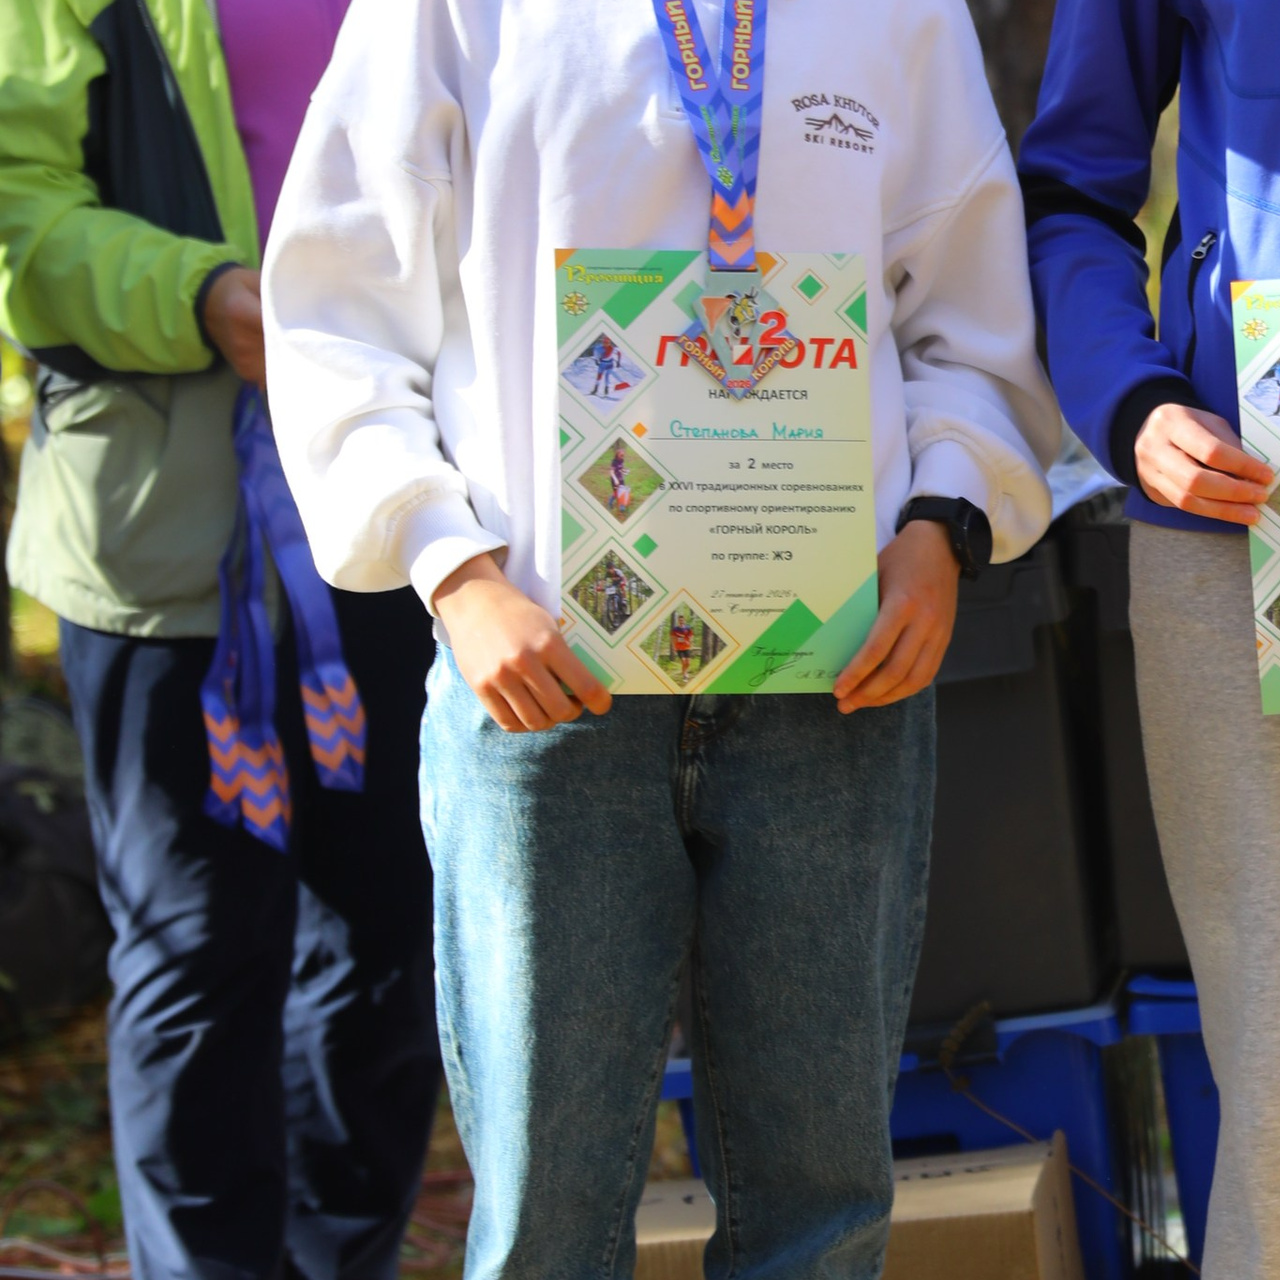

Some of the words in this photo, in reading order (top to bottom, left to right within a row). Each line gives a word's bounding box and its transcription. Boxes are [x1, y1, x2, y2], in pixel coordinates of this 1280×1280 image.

[791, 93, 831, 112] ROSA
[833, 94, 880, 131] KHUTOR
[804, 133, 824, 144] SKI
[830, 137, 874, 154] RESORT
[758, 311, 788, 347] 2
[676, 334, 727, 381] ГОРНЫЙ
[751, 337, 797, 382] КОРОЛЬ
[728, 461, 740, 469] за
[747, 458, 756, 469] 2
[762, 462, 794, 470] место
[668, 482, 694, 491] XXVI
[696, 483, 778, 493] традиционных
[781, 483, 864, 493] соревнованиях
[669, 505, 682, 513] по
[685, 504, 758, 515] спортивному
[761, 505, 856, 514] ориентированию
[709, 523, 763, 535] «ГОРНЫЙ
[765, 524, 818, 536] КОРОЛЬ»
[711, 552, 725, 560] по
[728, 552, 769, 562] группе:
[772, 550, 793, 561] ЖЭ
